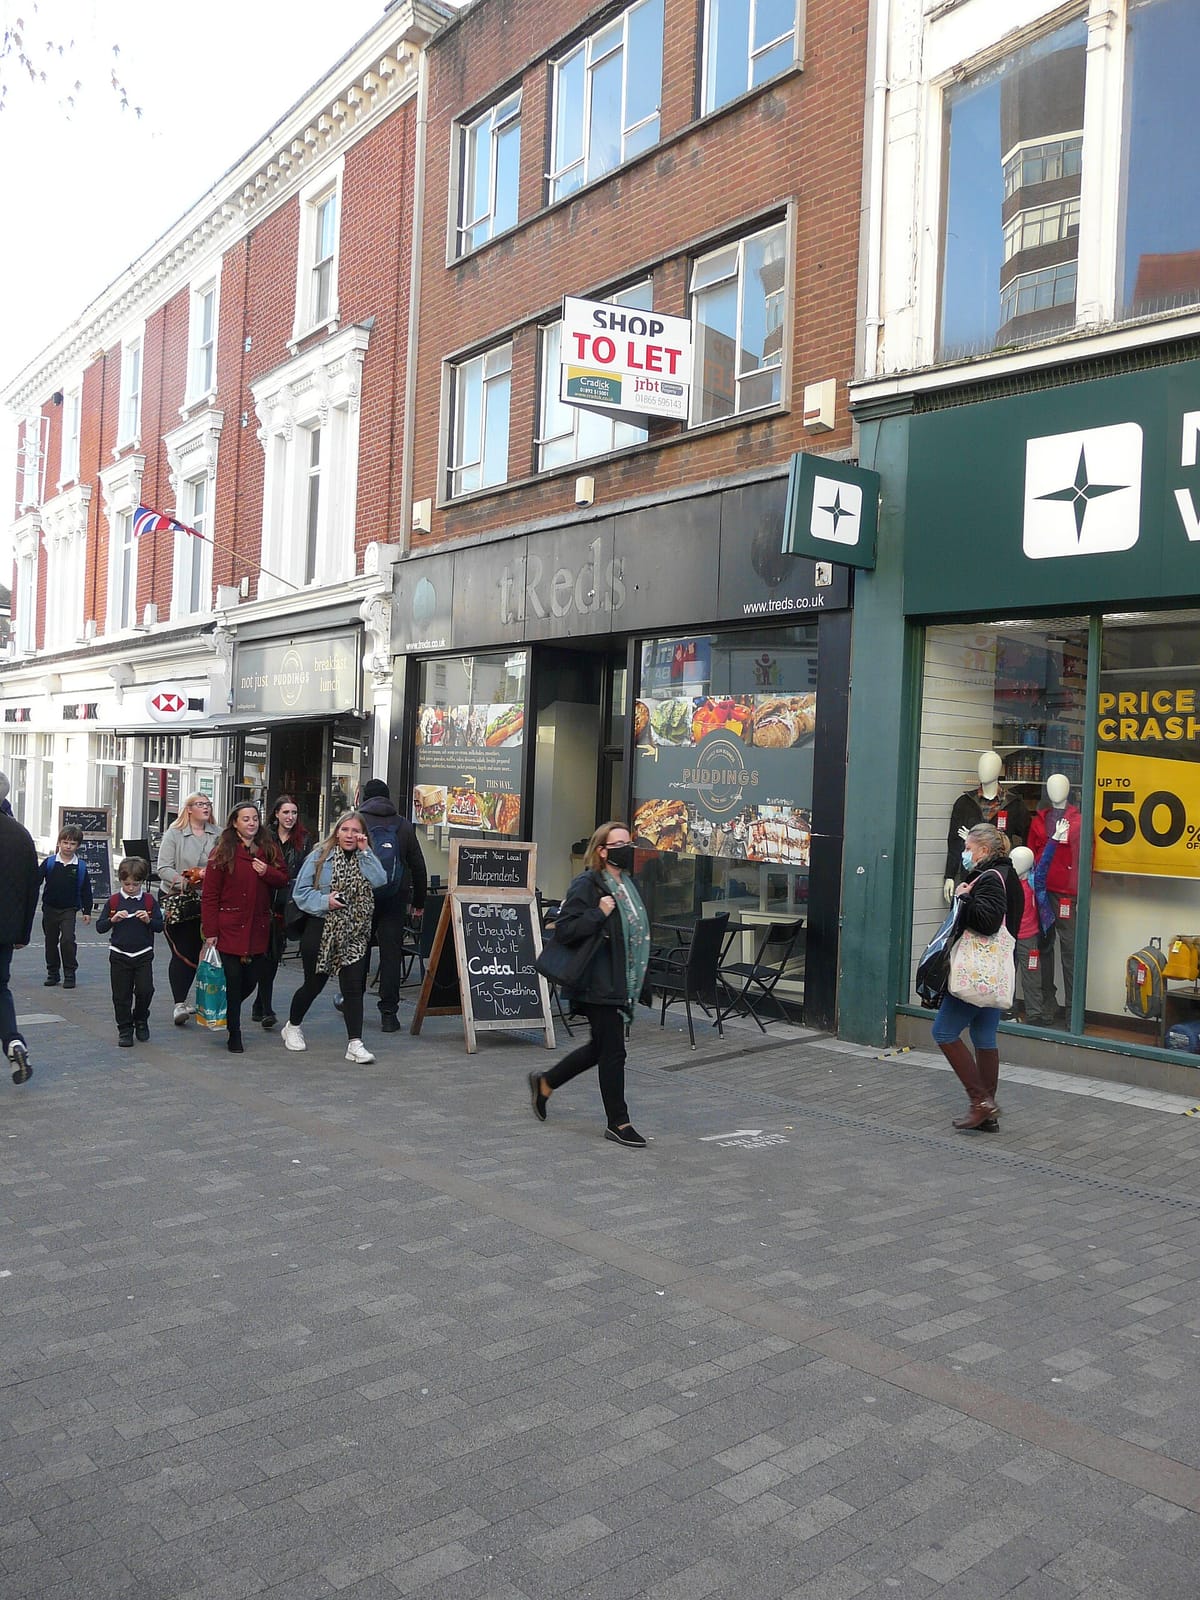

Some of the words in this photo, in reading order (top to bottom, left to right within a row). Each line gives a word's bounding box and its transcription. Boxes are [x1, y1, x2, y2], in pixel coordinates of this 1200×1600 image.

[593, 309, 664, 337] SHOP
[572, 332, 616, 364] TO
[627, 341, 682, 375] LET
[580, 377, 610, 390] Cradick
[634, 377, 659, 393] jrbt
[743, 593, 825, 614] www.treds.co.uk
[241, 674, 254, 689] not
[255, 671, 269, 692] just
[272, 671, 310, 686] PUDDINGS
[1097, 689, 1196, 716] PRICE
[1097, 716, 1200, 741] CRASH
[682, 769, 759, 786] PUDDINGS
[1098, 779, 1112, 788] UP
[1116, 778, 1131, 787] TO
[461, 848, 488, 864] Support
[492, 851, 505, 860] Your
[506, 851, 522, 861] Local
[468, 864, 520, 887] Independents
[477, 921, 505, 941] they
[505, 922, 517, 936] do
[517, 923, 526, 937] it
[477, 940, 494, 954] We
[495, 941, 508, 954] do
[510, 939, 519, 953] it
[468, 956, 515, 975] Costa
[470, 982, 494, 1002] Try
[493, 981, 540, 1005] Something
[493, 998, 521, 1017] New
